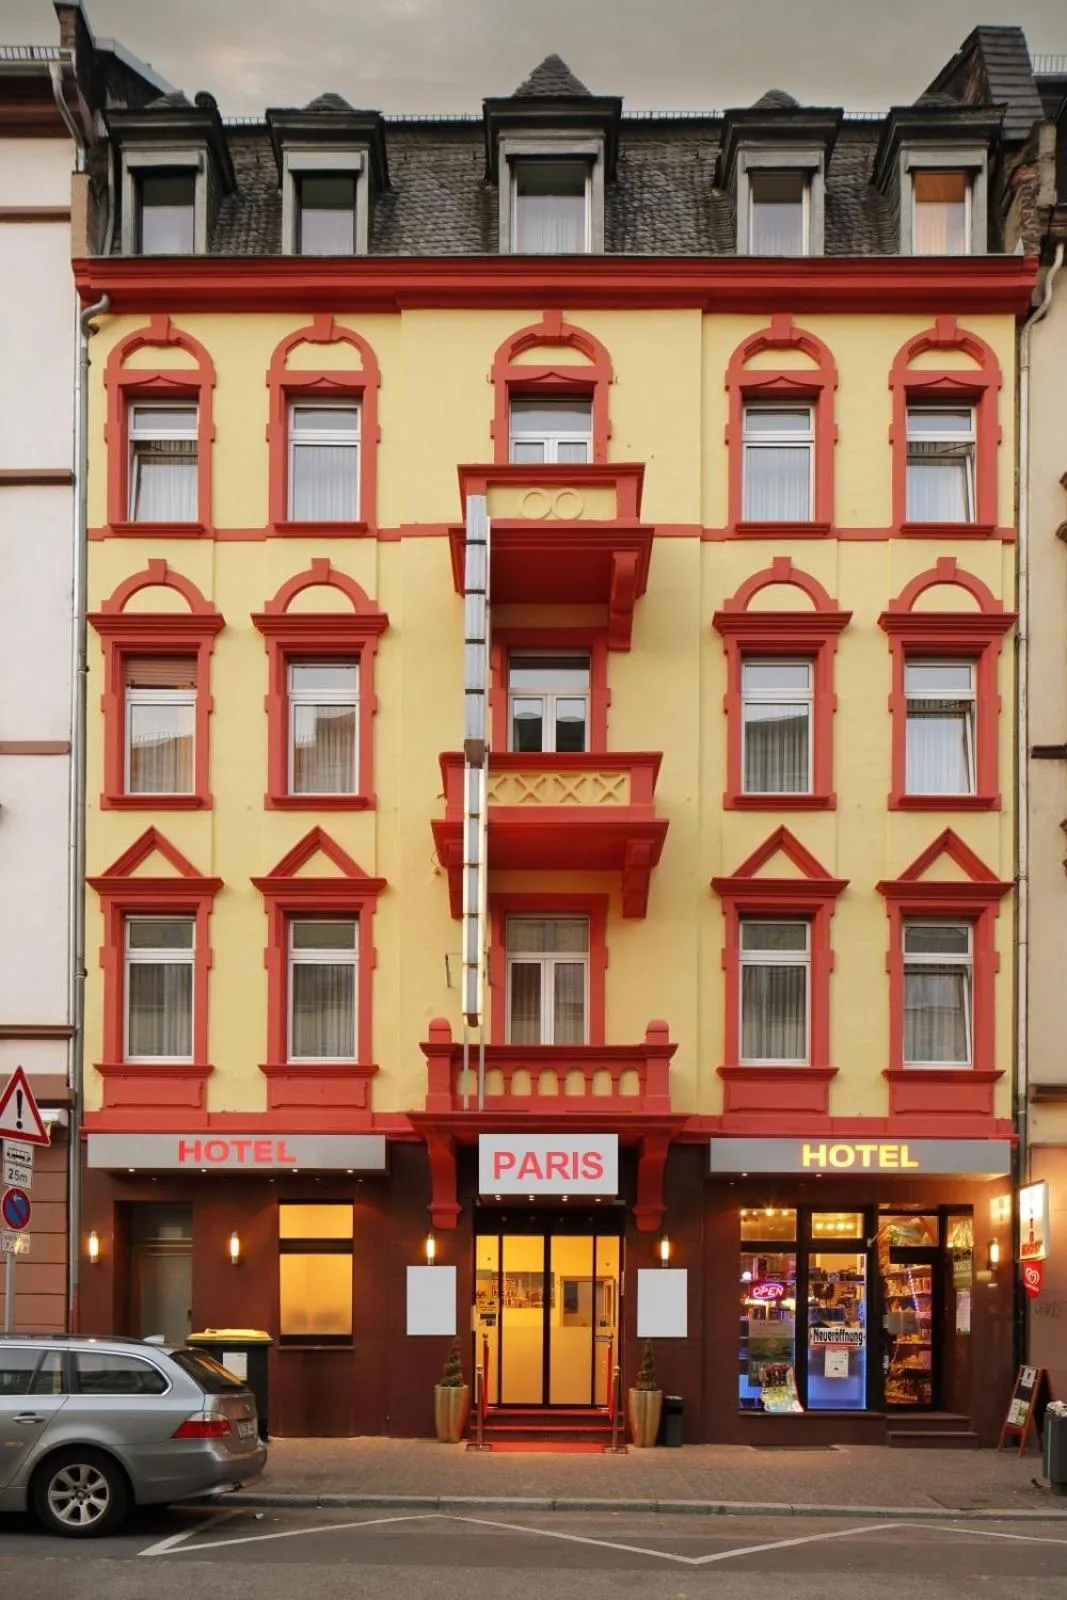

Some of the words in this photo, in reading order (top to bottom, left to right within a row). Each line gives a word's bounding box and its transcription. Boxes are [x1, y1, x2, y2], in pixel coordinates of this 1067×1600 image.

[178, 1140, 297, 1163] HOTEL
[802, 1144, 919, 1168] HOTEL
[8, 1168, 28, 1182] 25m
[493, 1151, 604, 1180] PARIS
[752, 1285, 784, 1297] OPEN
[813, 1328, 863, 1345] Neueröffnung
